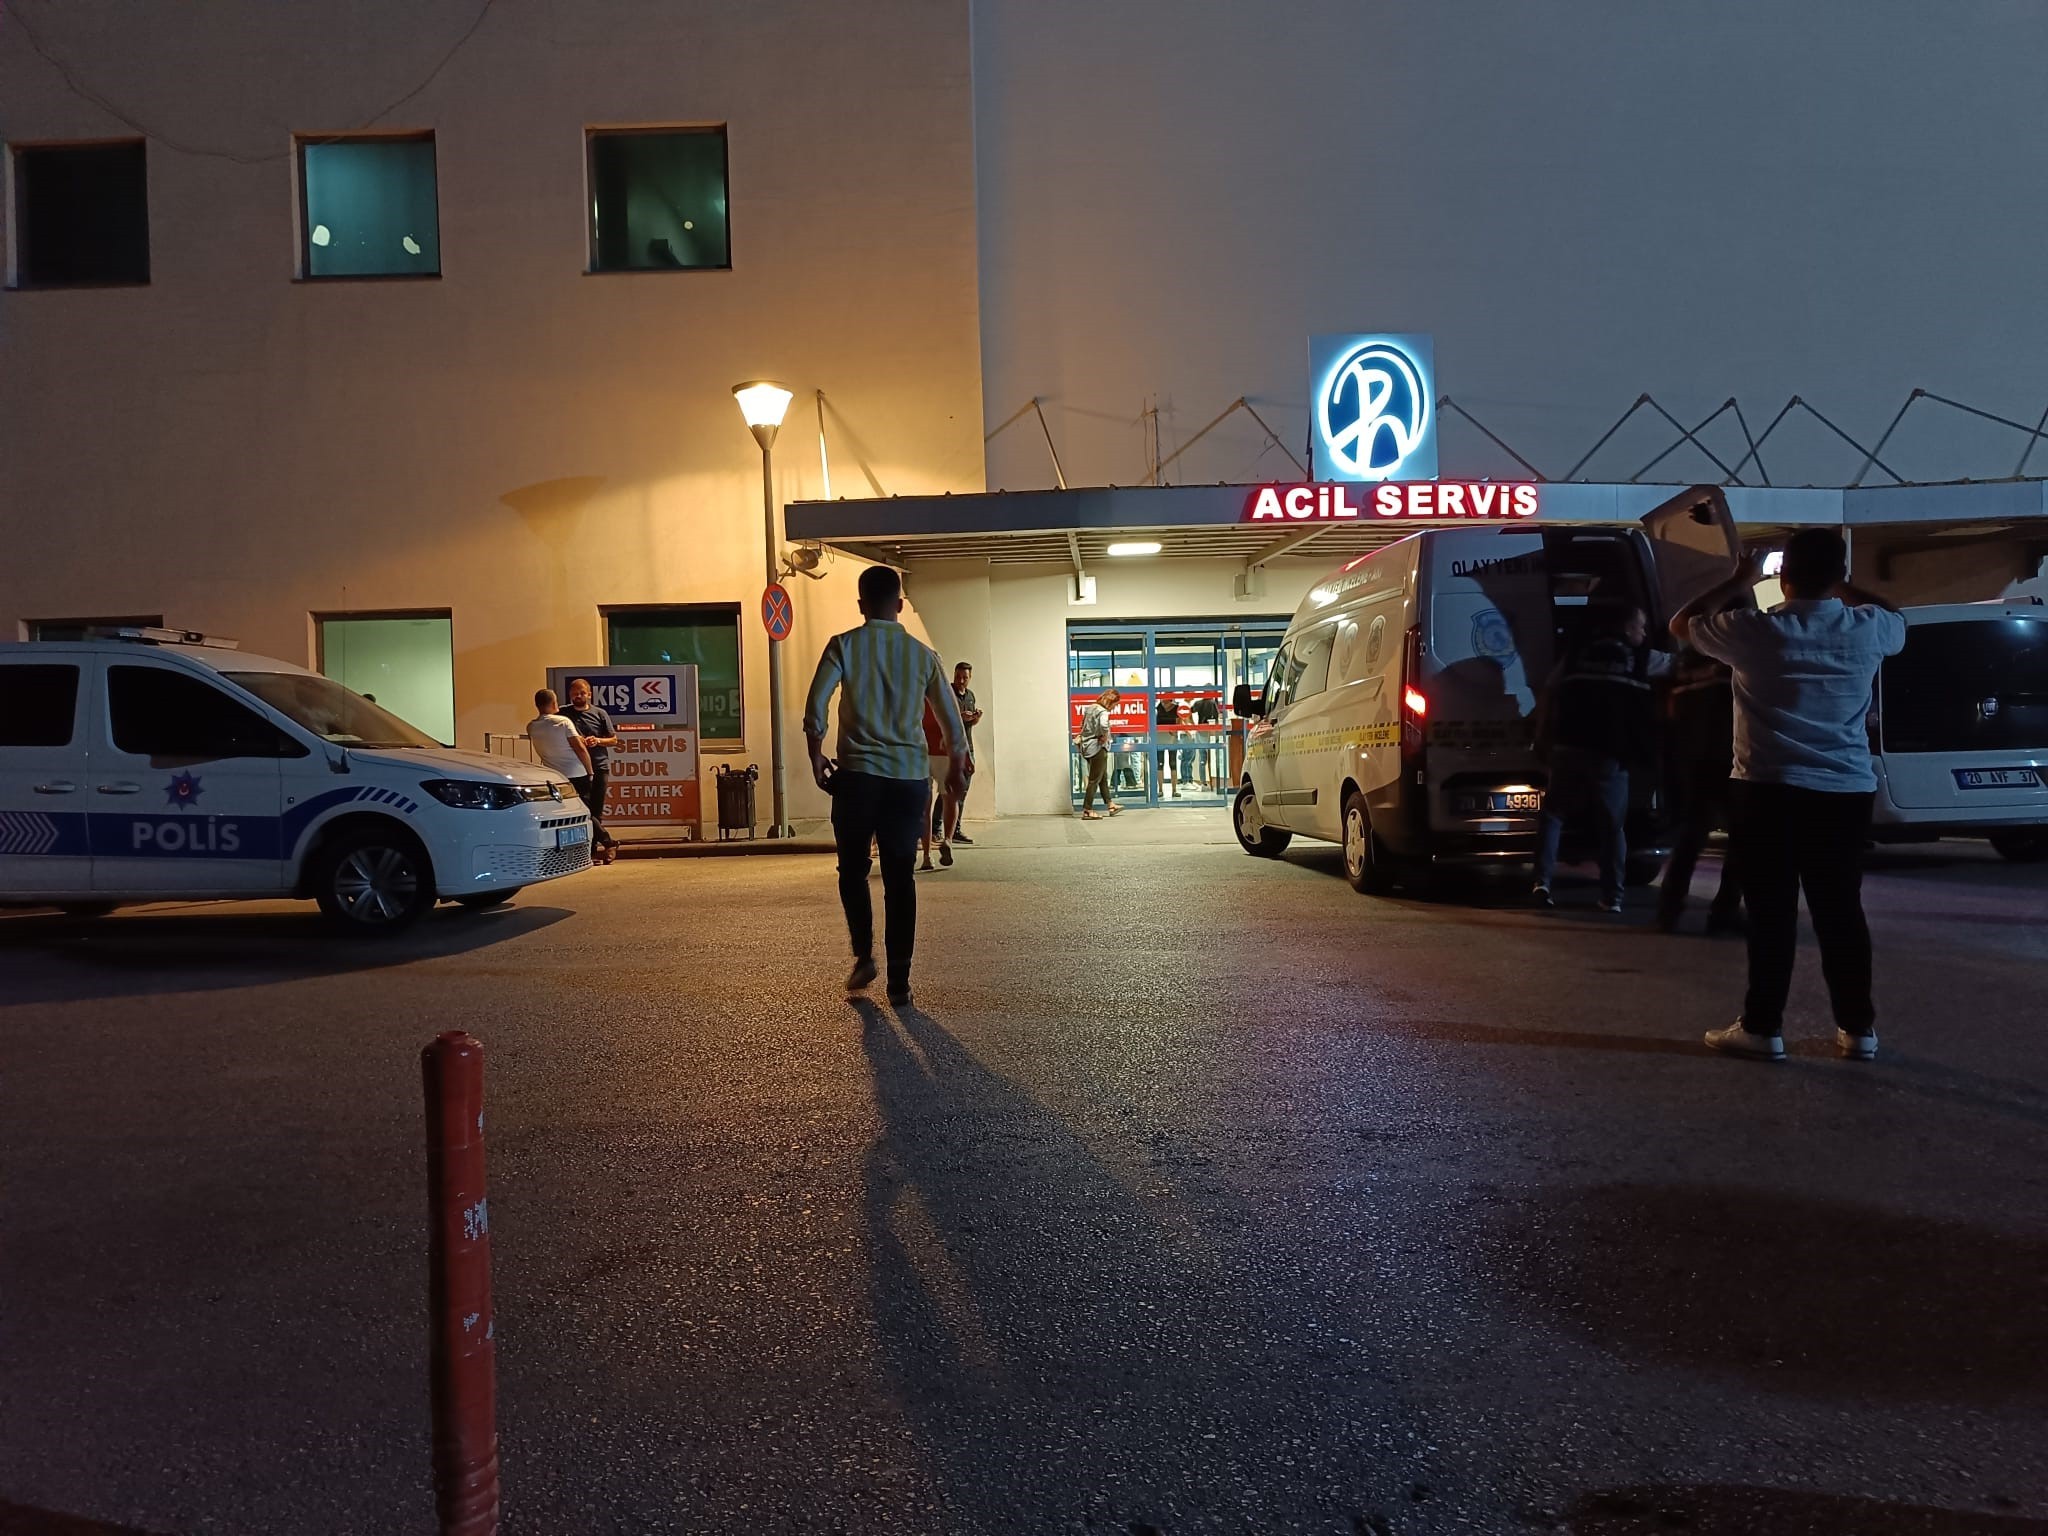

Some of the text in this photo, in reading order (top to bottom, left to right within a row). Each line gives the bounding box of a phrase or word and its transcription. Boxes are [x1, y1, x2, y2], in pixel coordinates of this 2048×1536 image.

[593, 685, 630, 712] KIŞ
[613, 735, 687, 753] SERVİS
[611, 760, 669, 776] ÜDÜR
[620, 785, 684, 798] ETMEK
[602, 803, 671, 816] SAKTIR
[132, 817, 240, 850] POLİS
